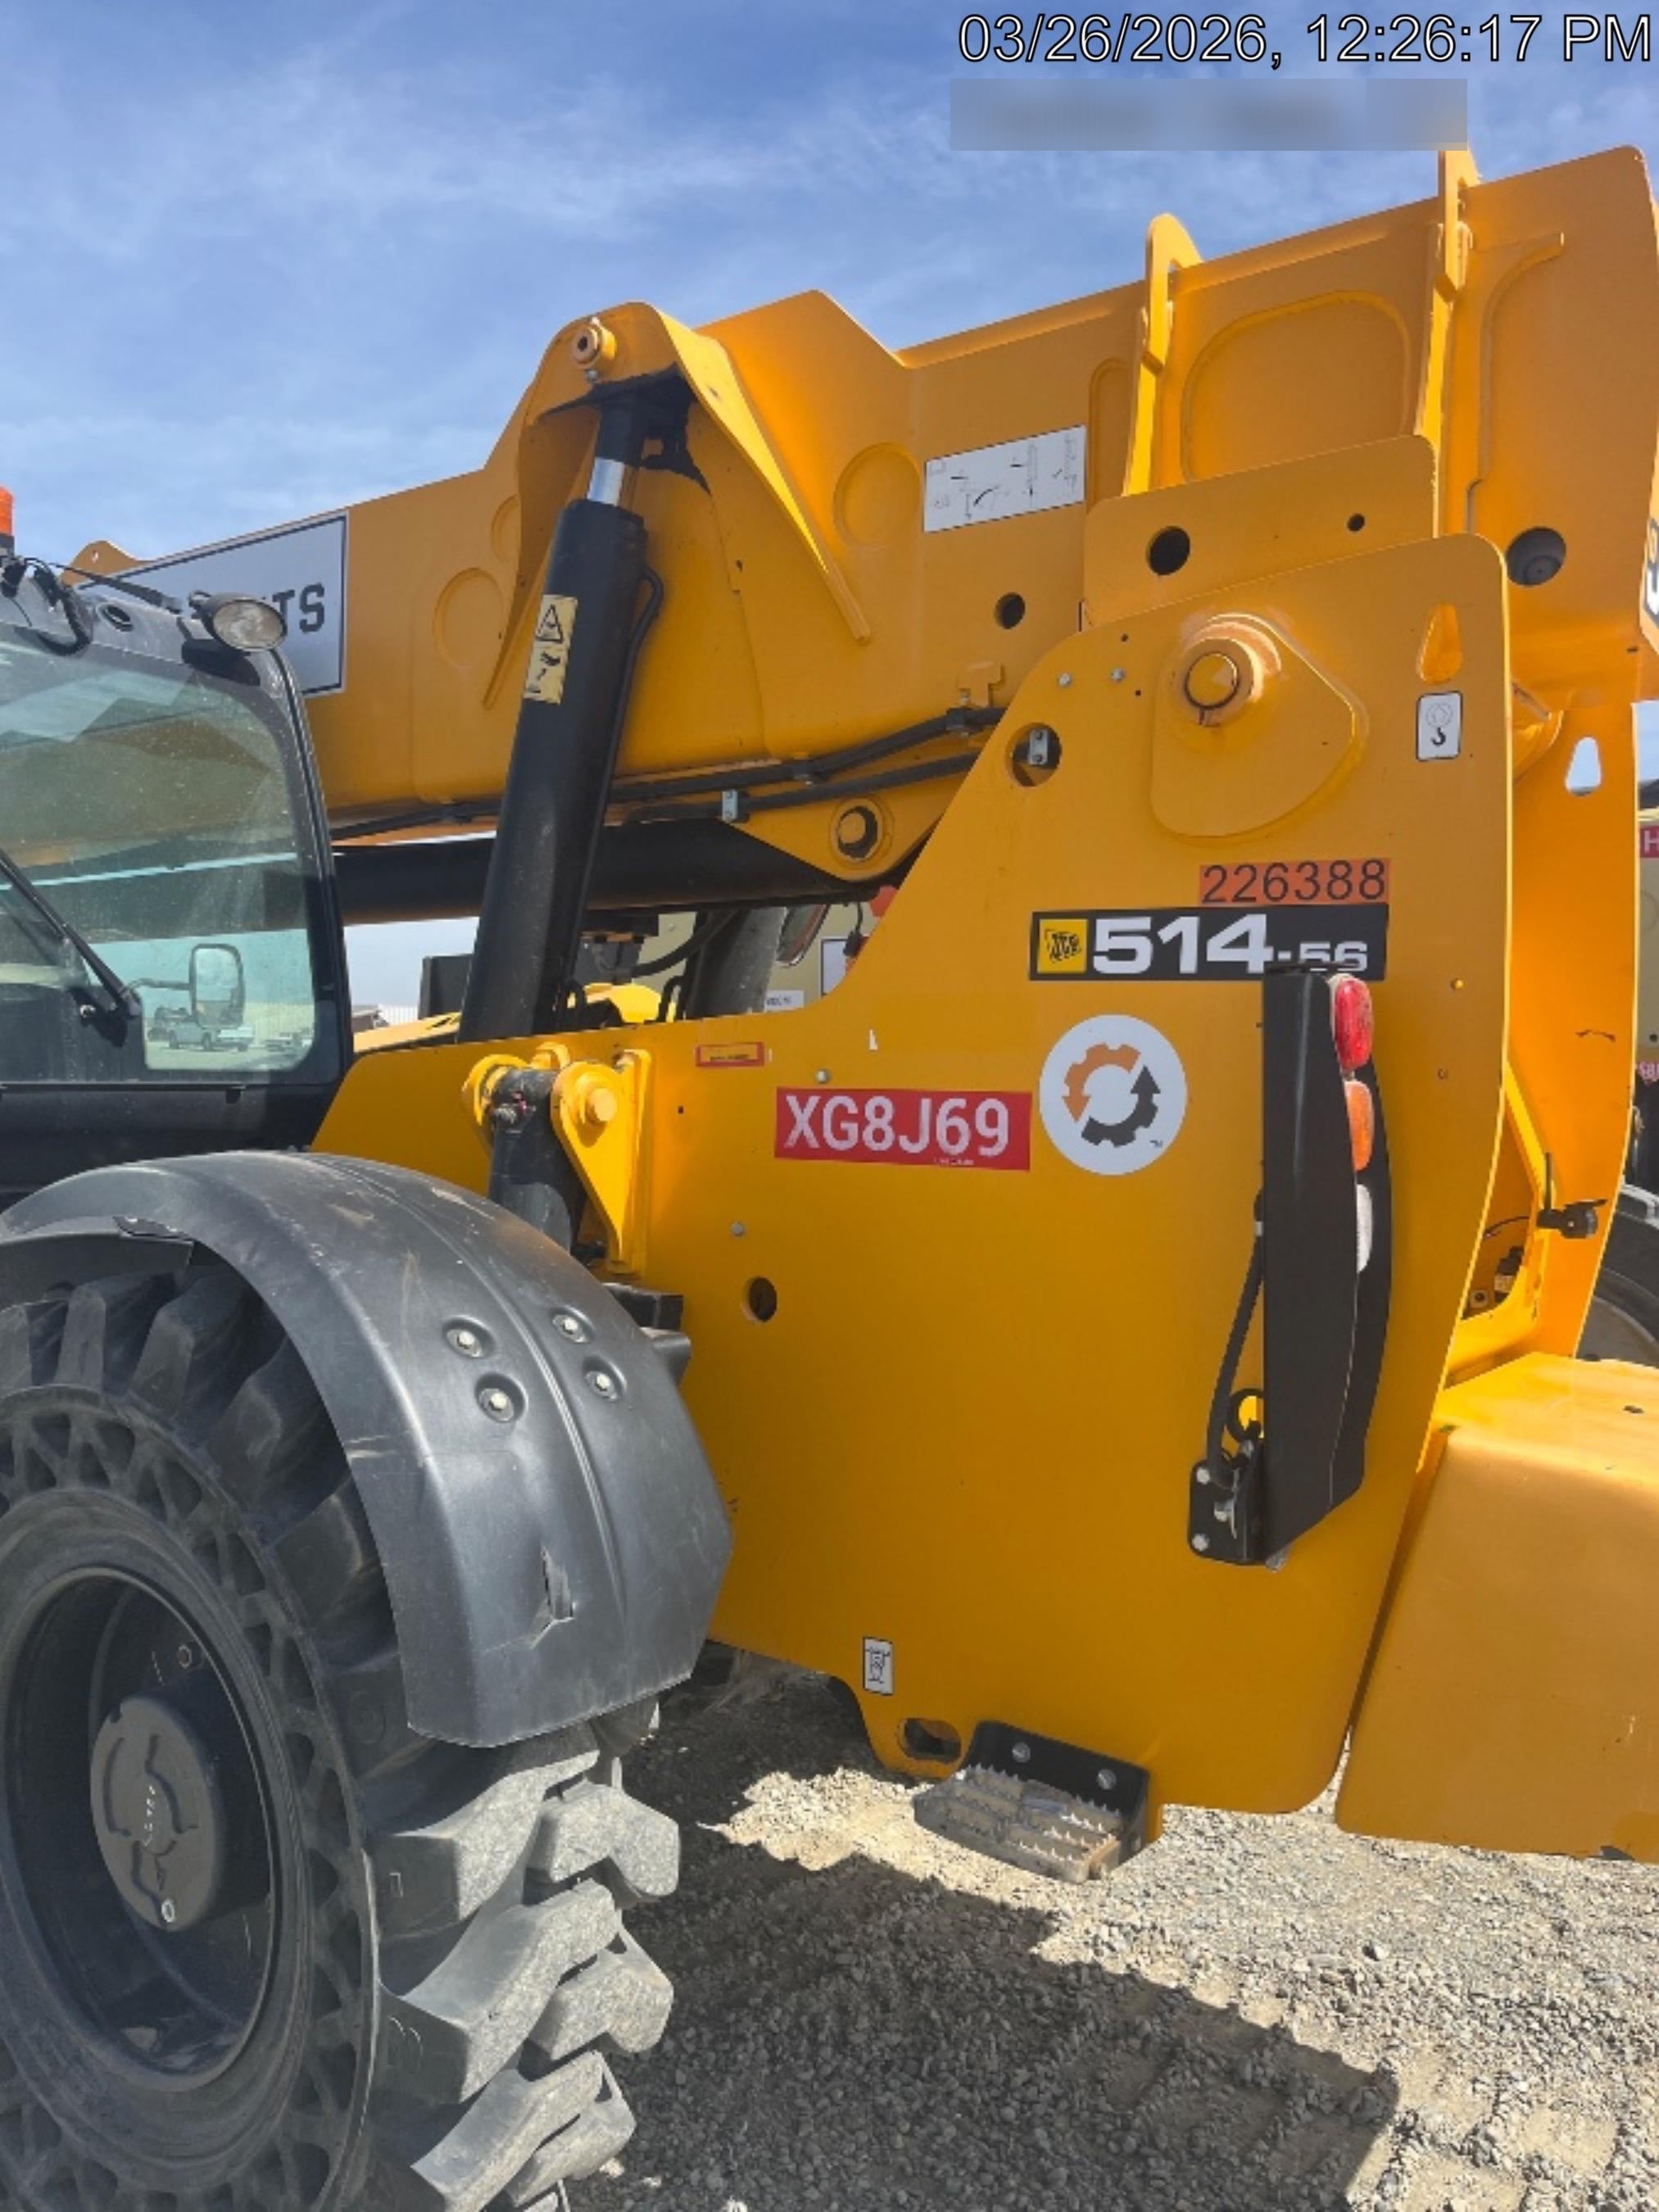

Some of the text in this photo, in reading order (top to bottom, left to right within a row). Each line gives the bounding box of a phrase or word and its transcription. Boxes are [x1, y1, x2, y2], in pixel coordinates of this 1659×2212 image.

[261, 582, 325, 634] TS
[1202, 859, 1386, 904] 226388
[783, 1095, 1009, 1158] XG8J69
